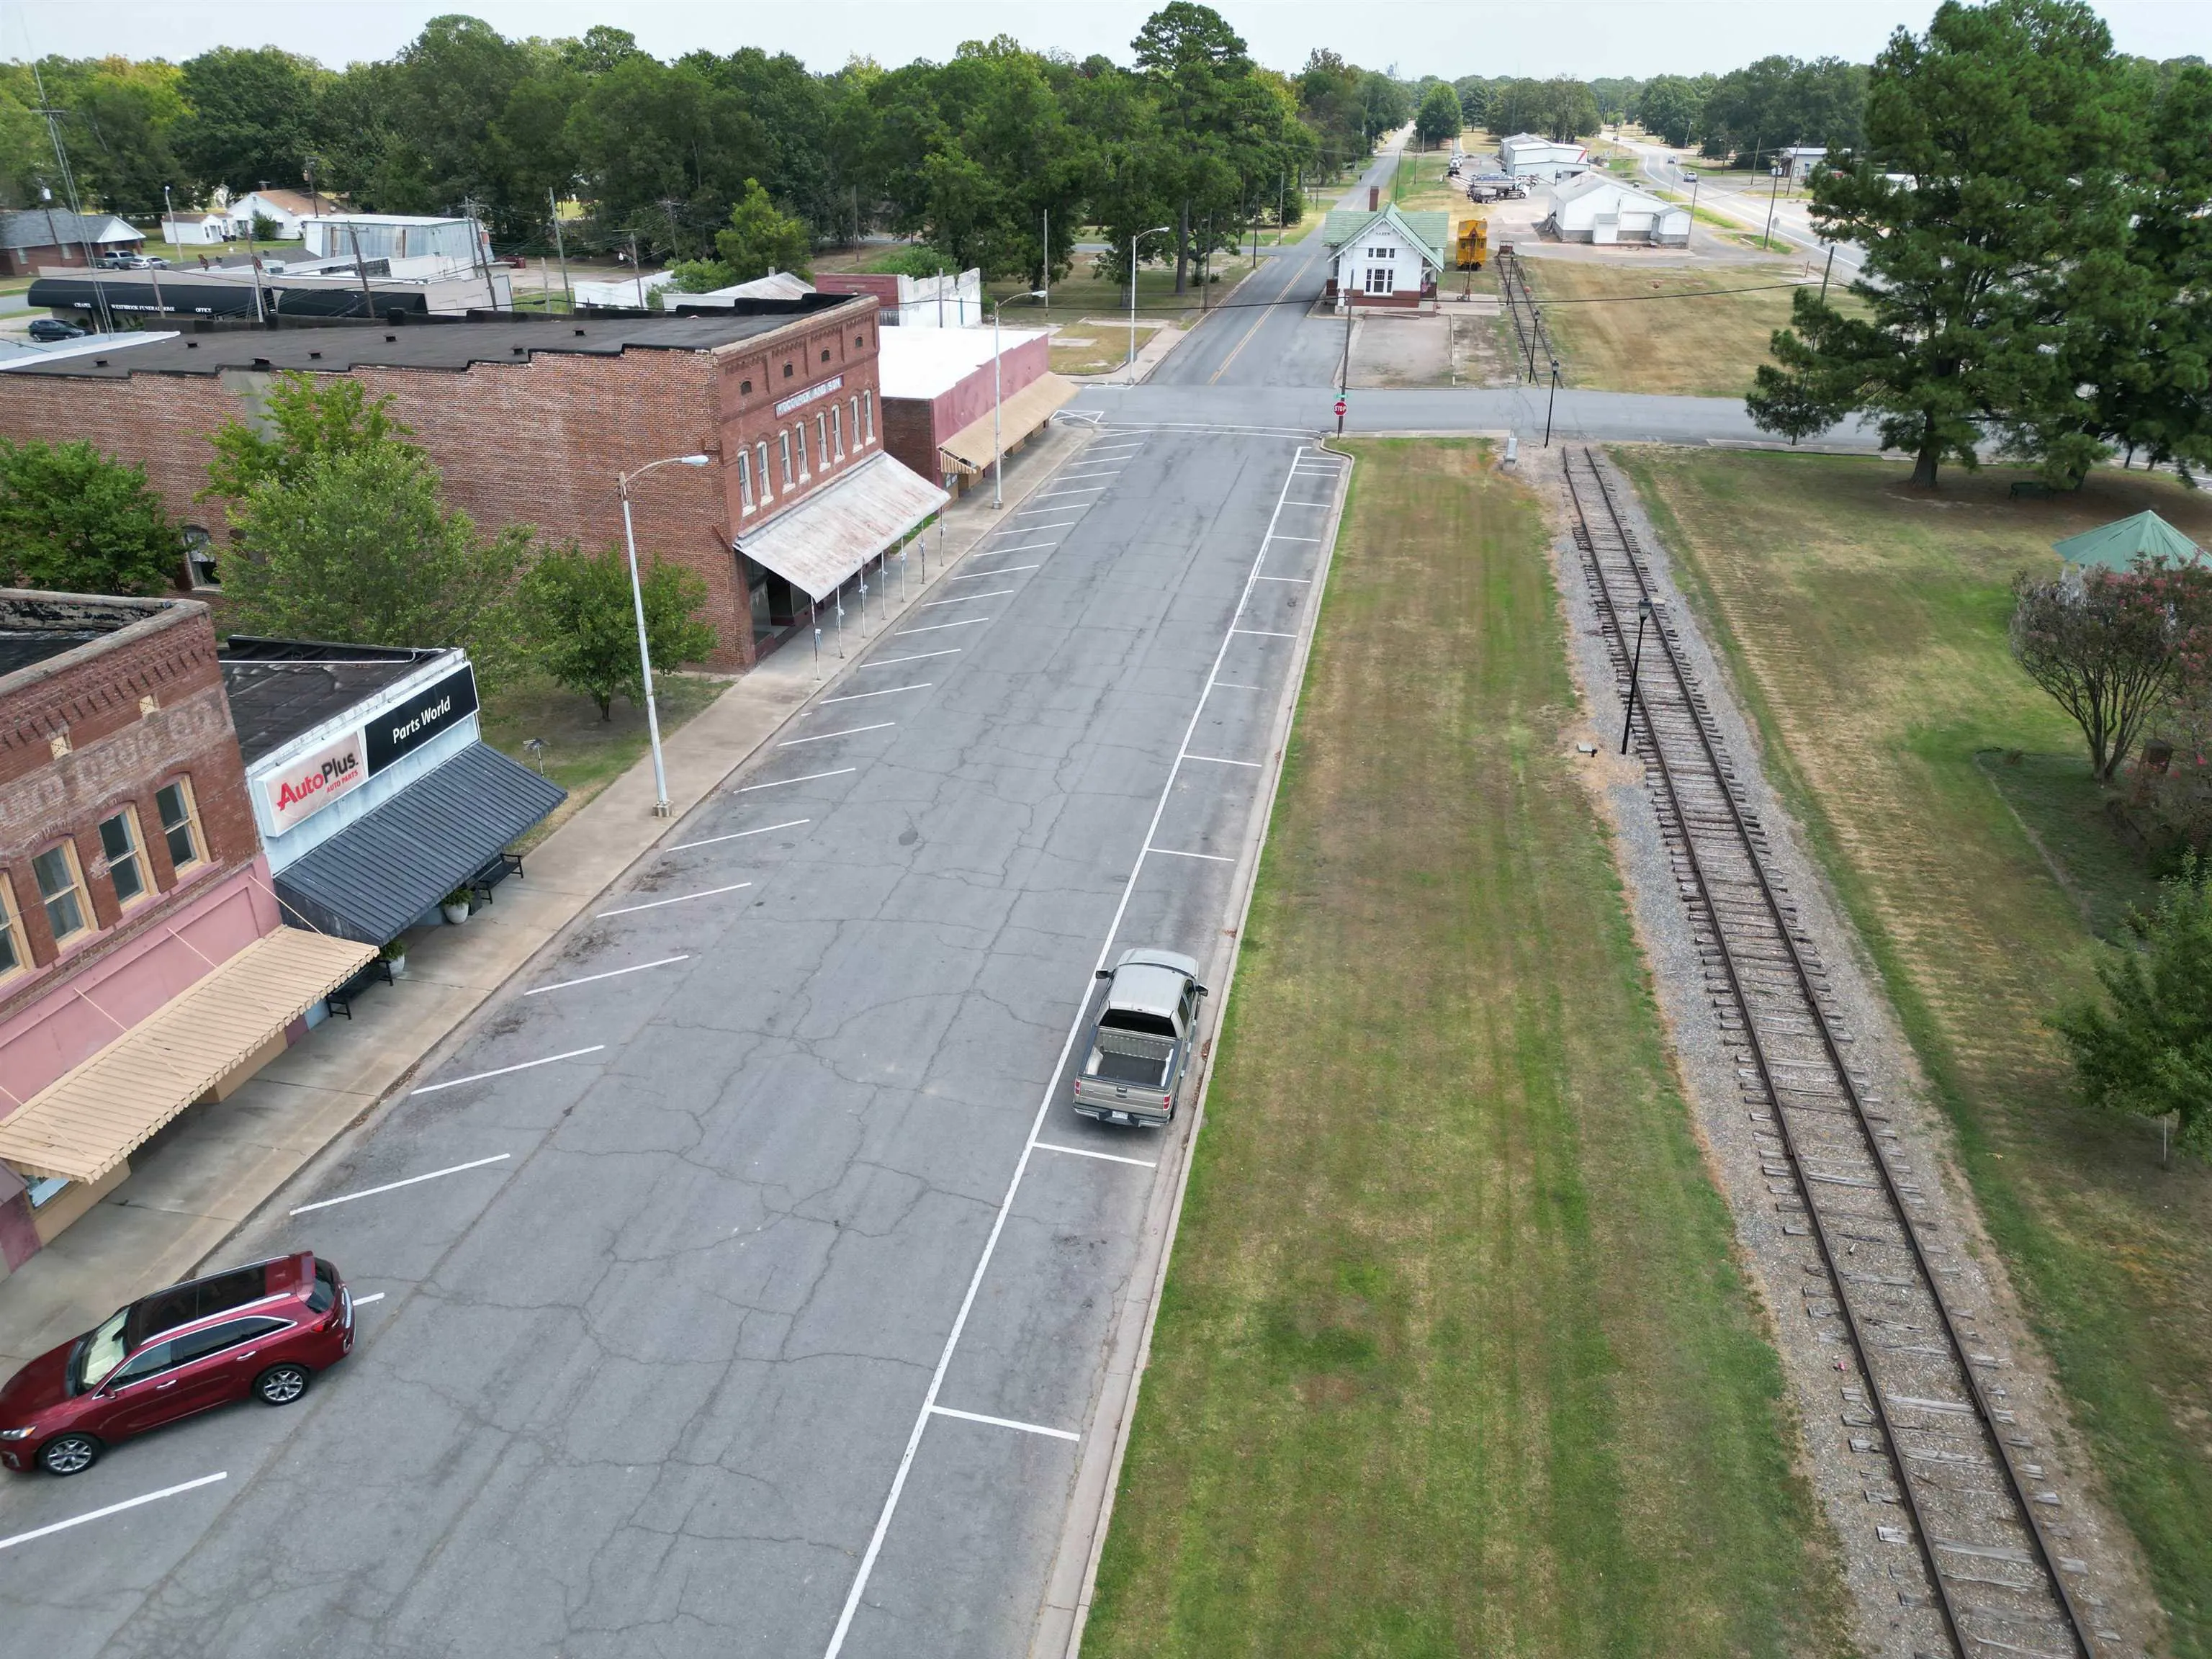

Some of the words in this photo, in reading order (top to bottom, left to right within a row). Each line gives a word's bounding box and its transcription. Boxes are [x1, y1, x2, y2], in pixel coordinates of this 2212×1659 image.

[811, 383, 825, 398] AND
[827, 377, 840, 391] SON
[392, 719, 420, 744] Parts
[421, 696, 451, 725] World
[326, 781, 341, 793] AUTO
[341, 770, 359, 786] PARTS
